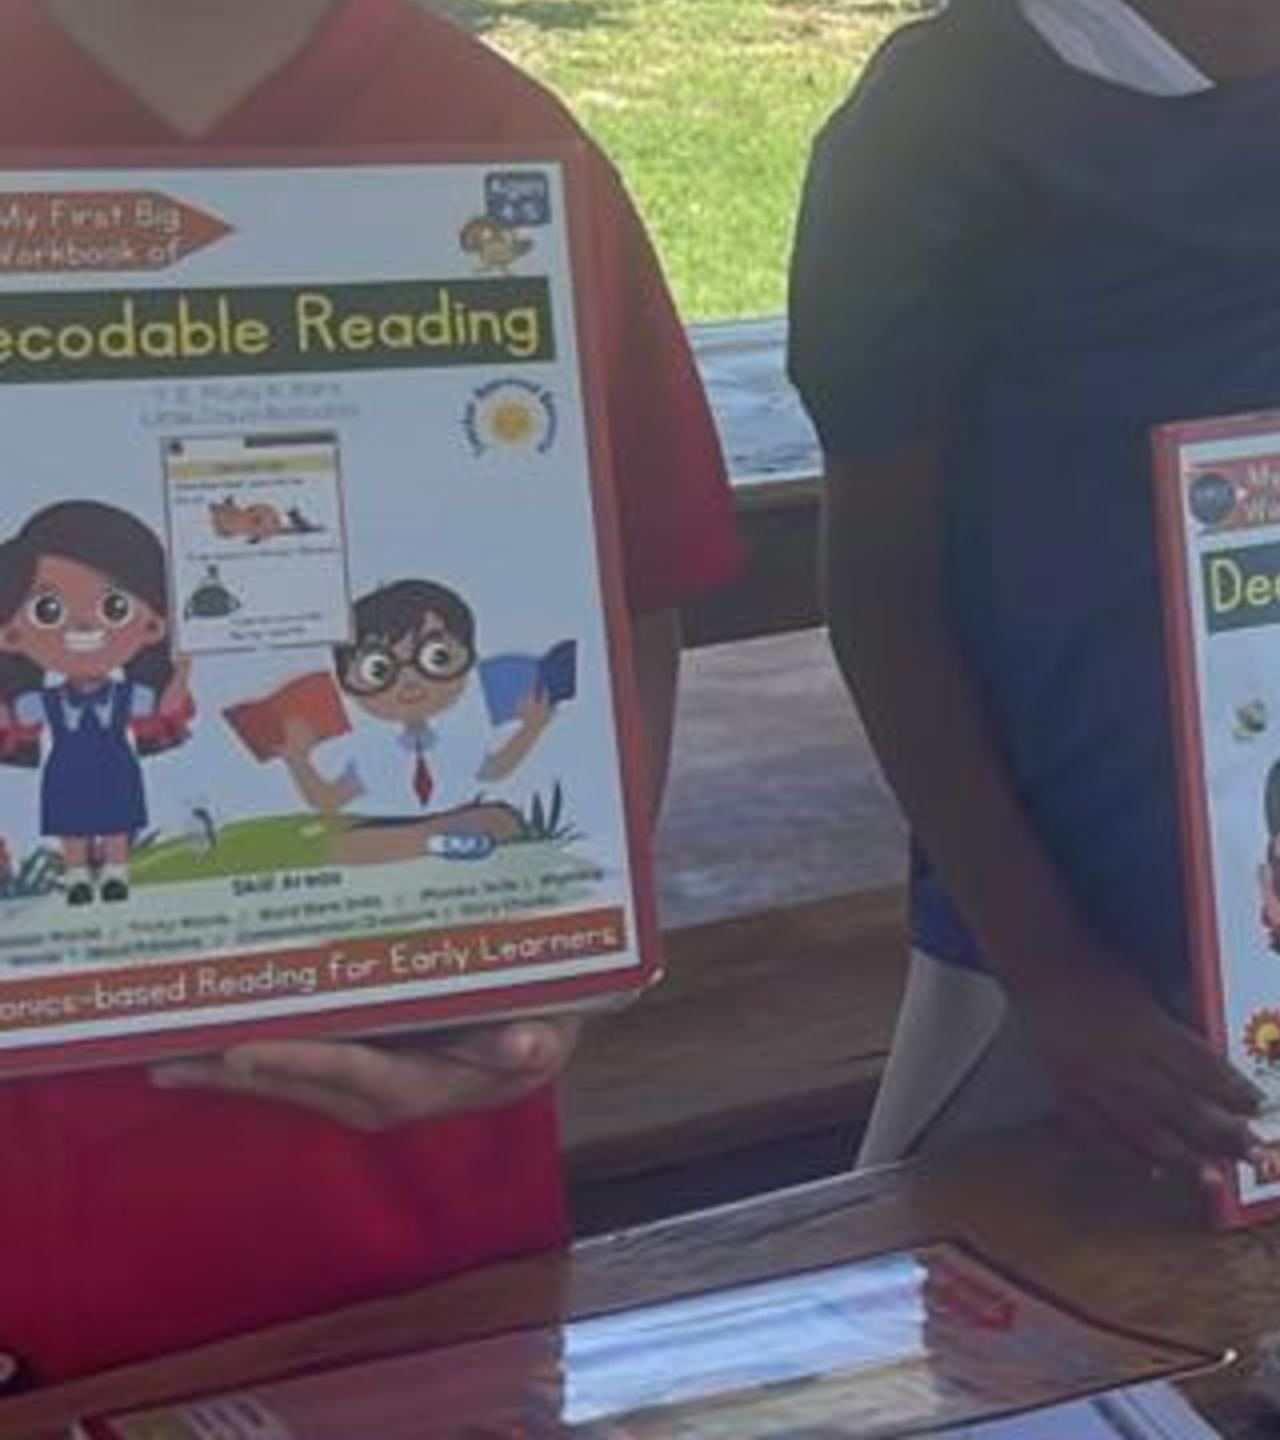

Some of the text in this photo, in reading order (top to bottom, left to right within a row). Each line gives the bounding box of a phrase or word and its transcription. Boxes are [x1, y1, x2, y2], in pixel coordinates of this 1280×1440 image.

[51, 199, 122, 227] First
[135, 199, 181, 233] Big
[149, 237, 181, 260] of
[296, 287, 538, 357] Reading
[198, 962, 318, 994] Reading
[328, 949, 378, 981] for
[390, 940, 471, 973] Early
[480, 927, 619, 961] Learners
